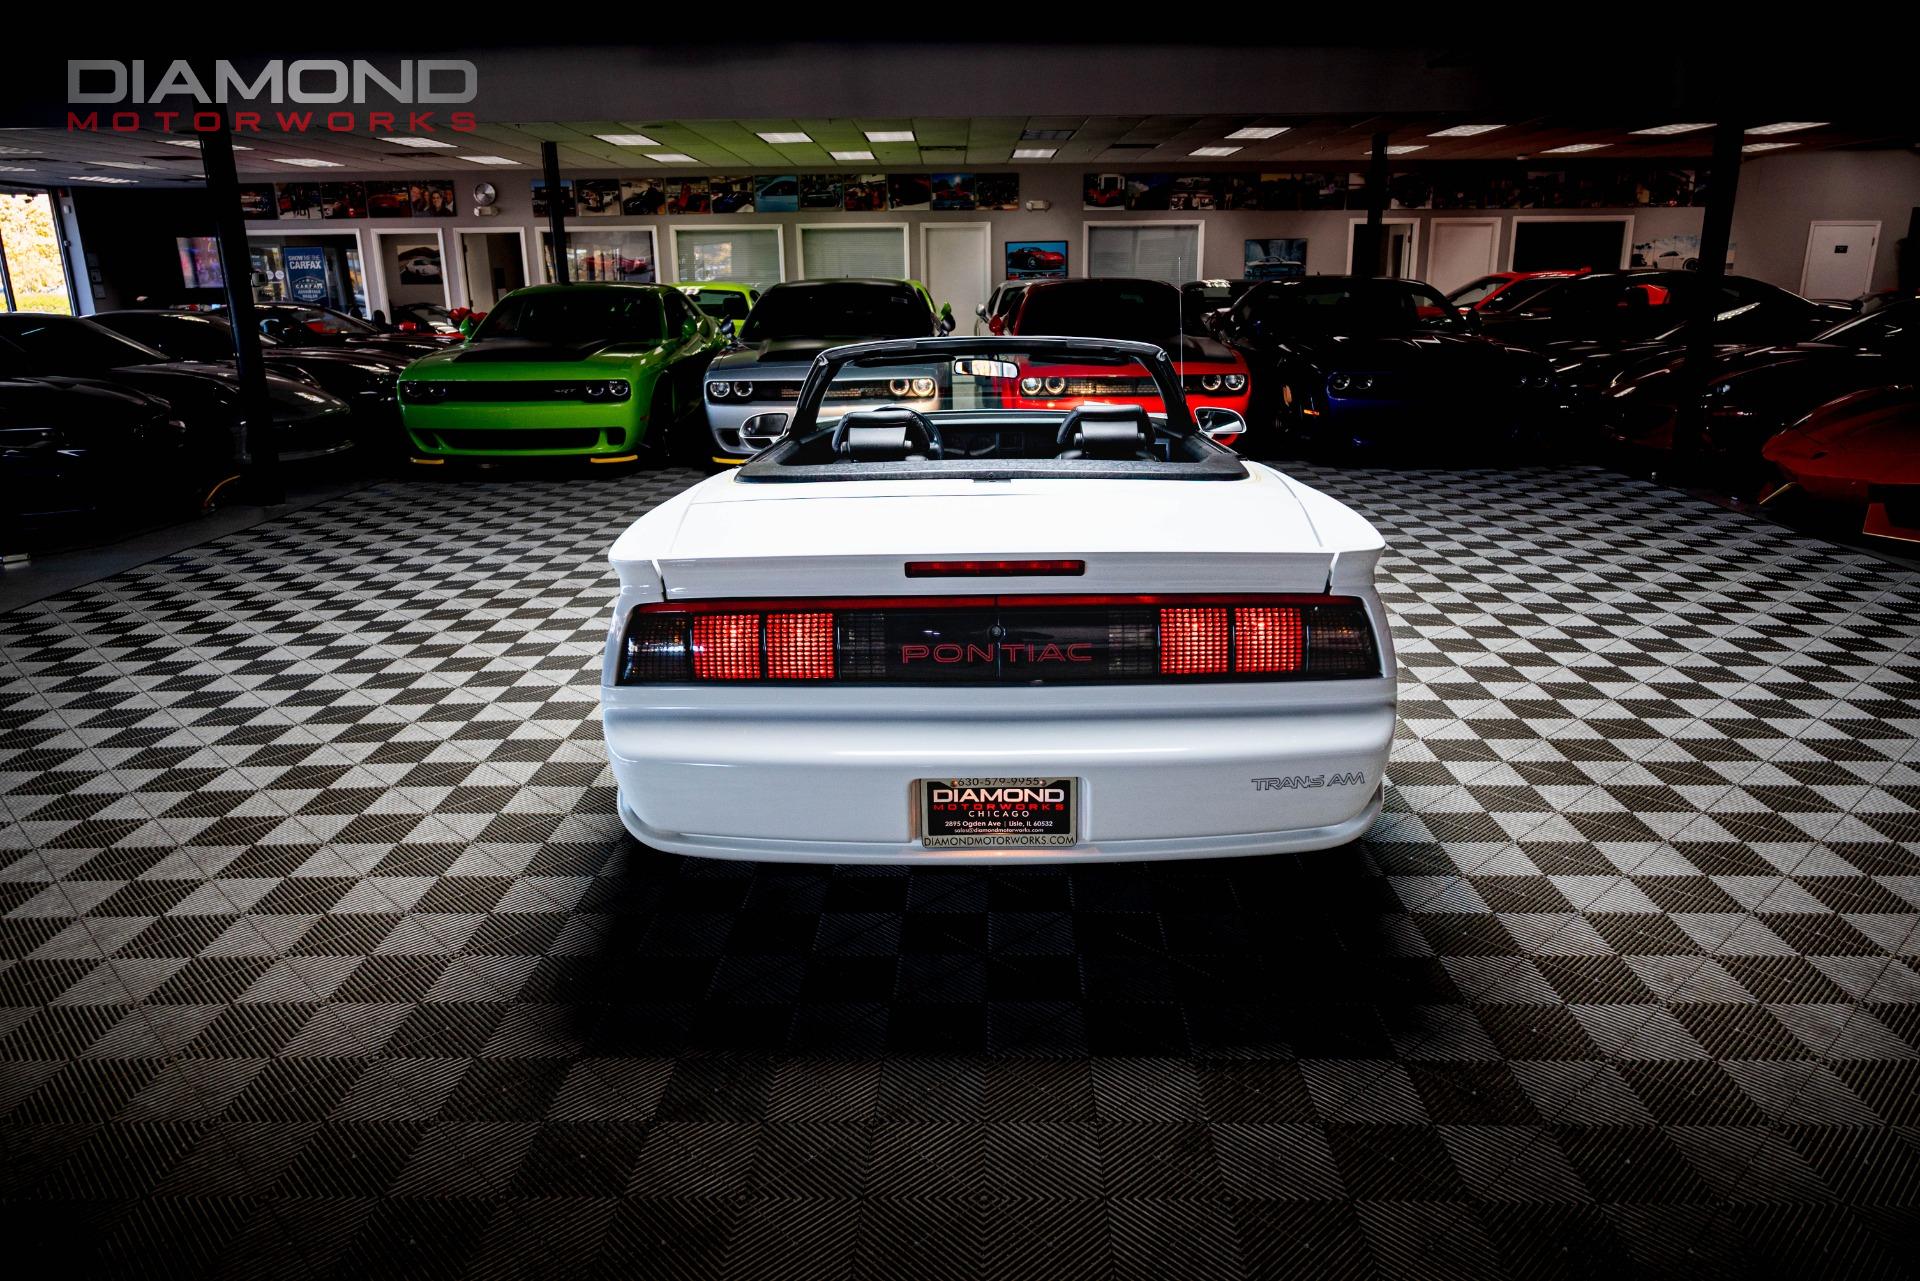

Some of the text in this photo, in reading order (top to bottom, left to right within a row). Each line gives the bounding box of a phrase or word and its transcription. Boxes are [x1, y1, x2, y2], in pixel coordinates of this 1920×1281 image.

[289, 261, 322, 270] CARFAX
[902, 643, 1093, 664] PONTIAC
[958, 777, 1040, 786] 630-579-9955
[1251, 771, 1365, 791] TRANS AM
[933, 788, 1065, 803] DIAMOND
[932, 803, 1065, 811] MOTORWORKS
[968, 810, 1030, 818] CHICAGO
[962, 820, 986, 828] Ogden
[924, 835, 1075, 847] DIAMONDMOTORWORKS.COM
